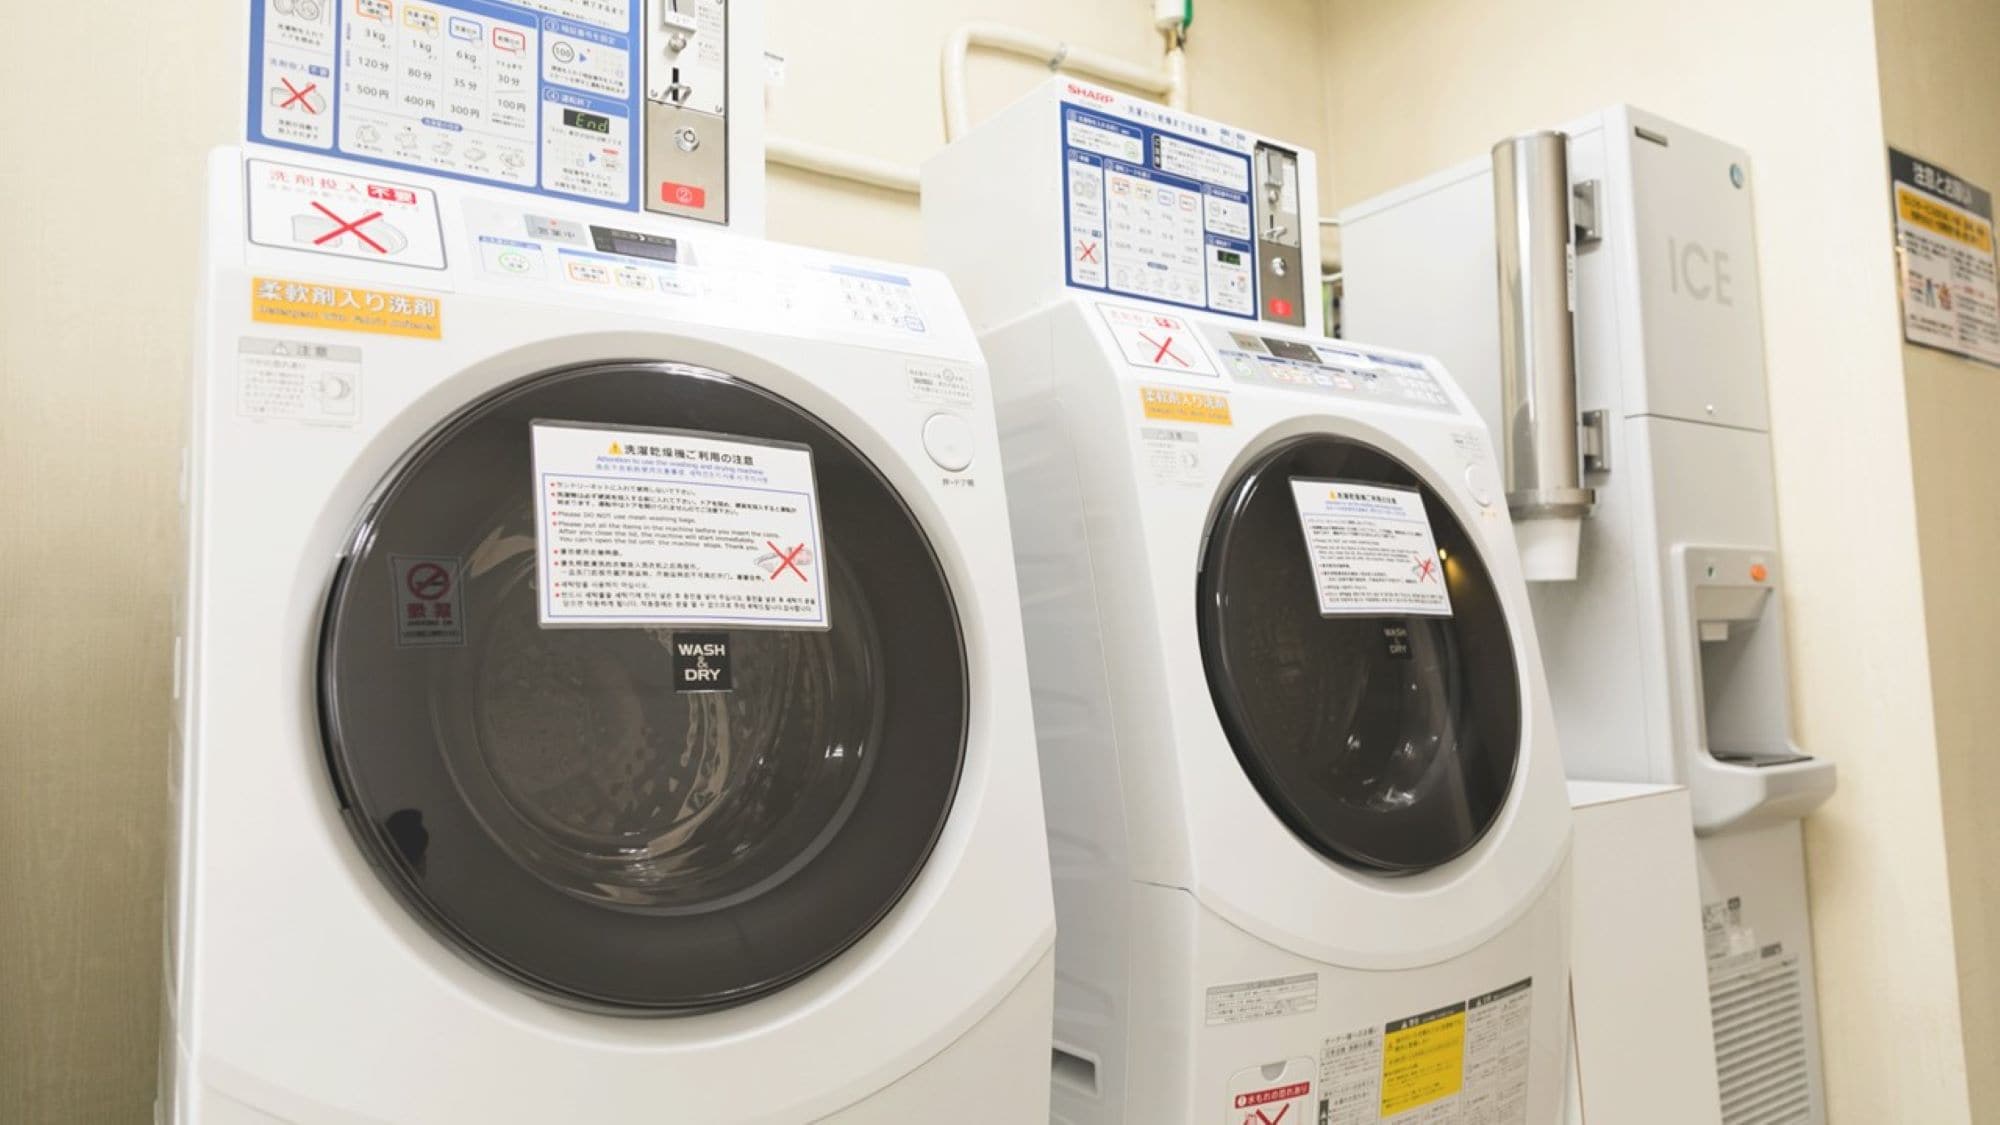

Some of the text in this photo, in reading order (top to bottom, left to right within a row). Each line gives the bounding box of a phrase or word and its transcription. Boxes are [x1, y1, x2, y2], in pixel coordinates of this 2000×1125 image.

[1067, 83, 1114, 104] SHARP
[1667, 235, 1734, 308] ICE
[255, 279, 437, 318] 柔軟剤入り洗剤
[624, 444, 754, 466] 洗濯乾燥機ご利用の注意
[678, 643, 726, 656] WASH
[697, 655, 708, 668] &
[684, 668, 721, 682] DRY
